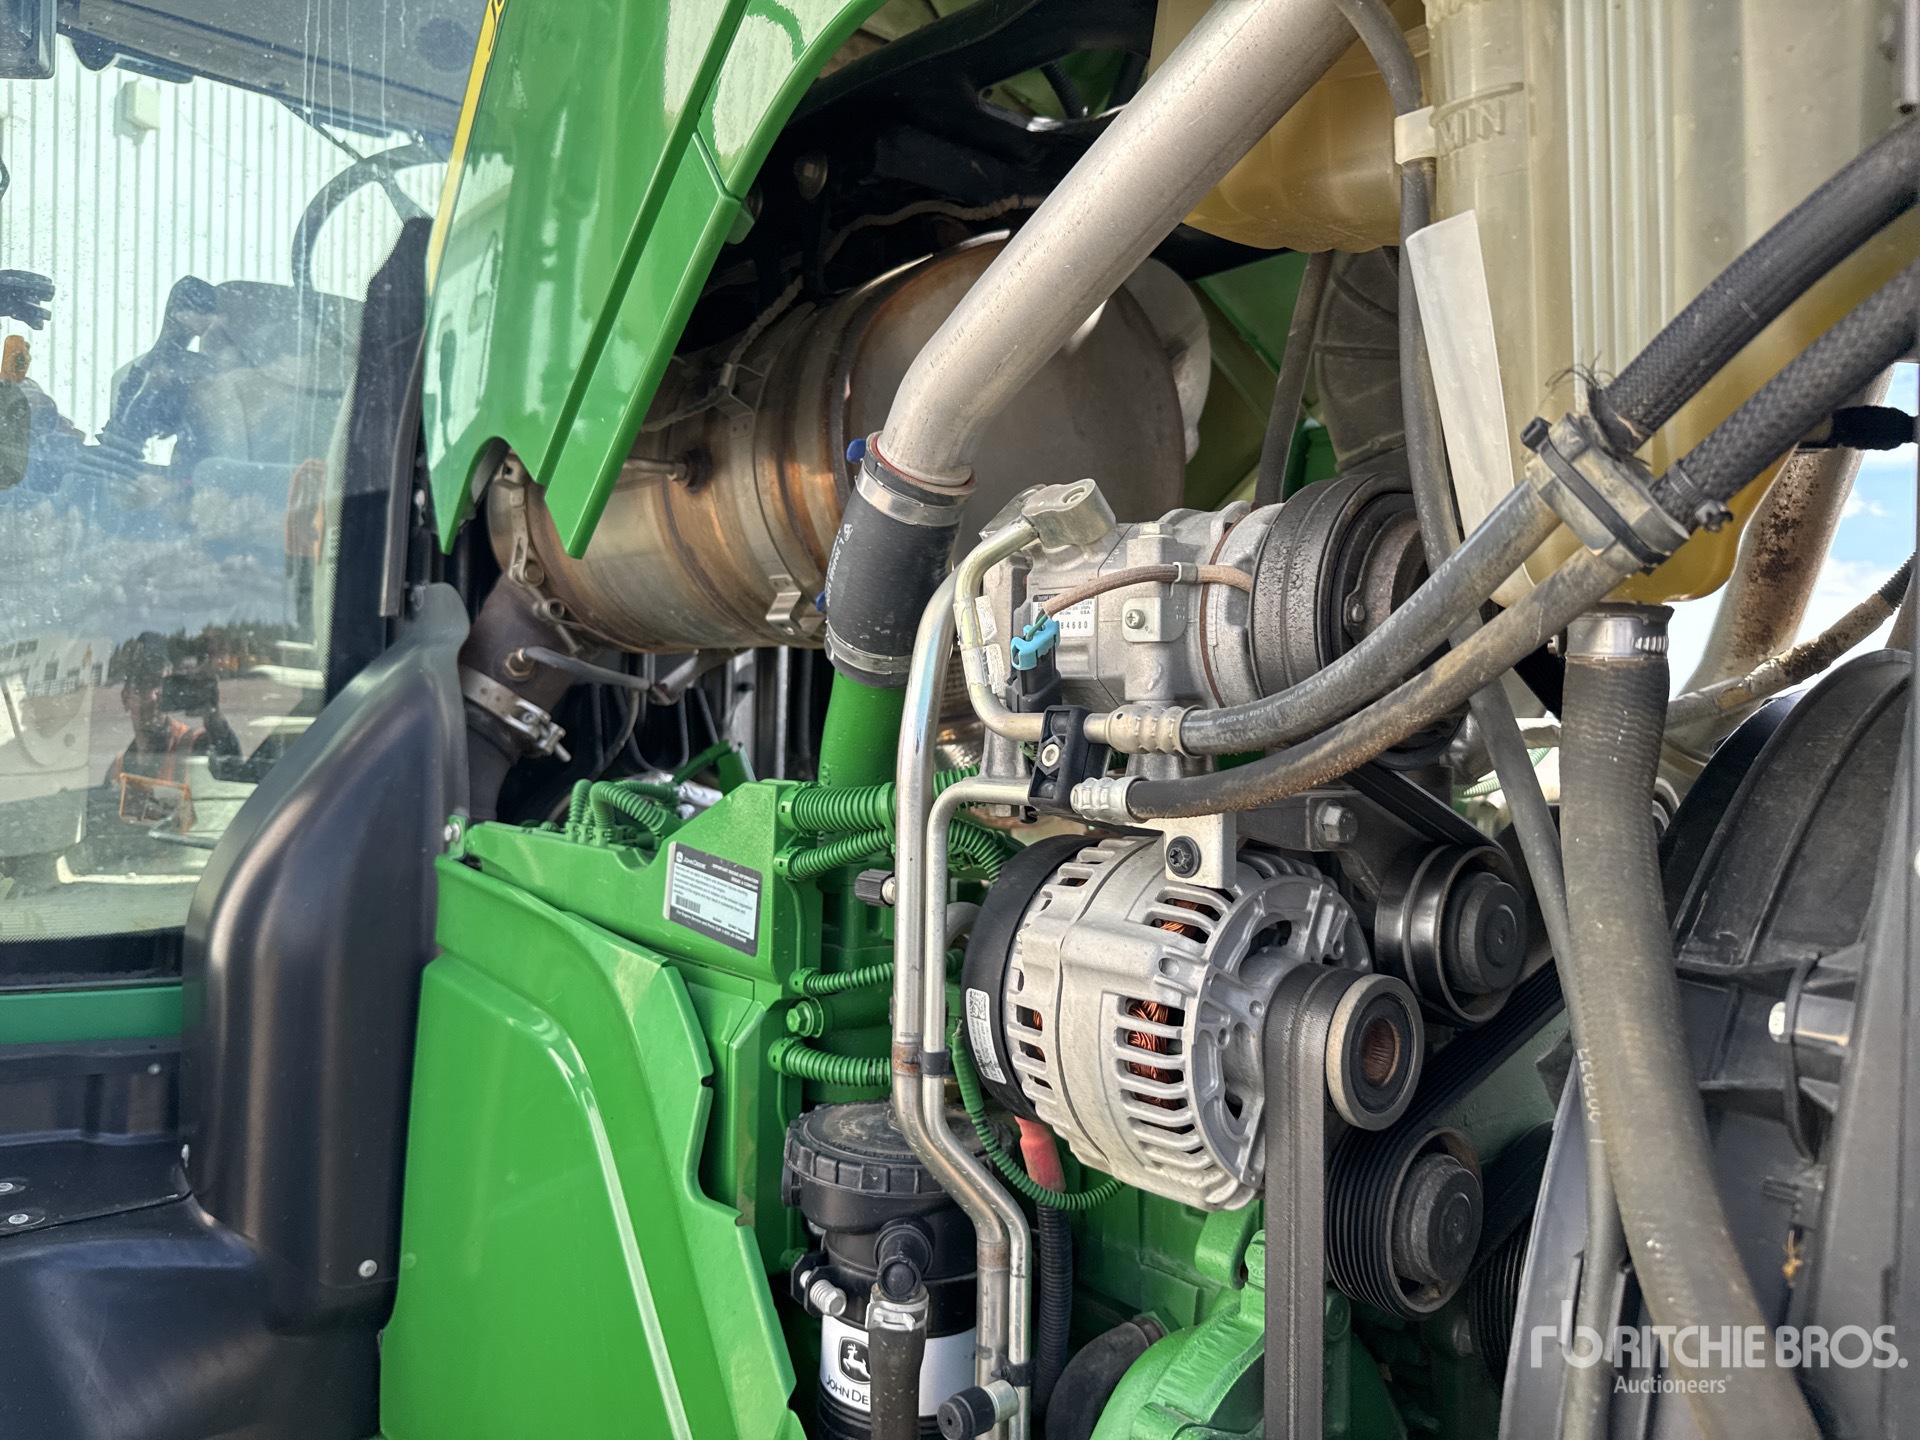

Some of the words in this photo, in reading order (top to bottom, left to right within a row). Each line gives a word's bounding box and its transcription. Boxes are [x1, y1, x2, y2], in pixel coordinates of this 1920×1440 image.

[1437, 100, 1506, 157] MIN
[826, 1374, 850, 1399] JOHN
[852, 1389, 870, 1405] DE
